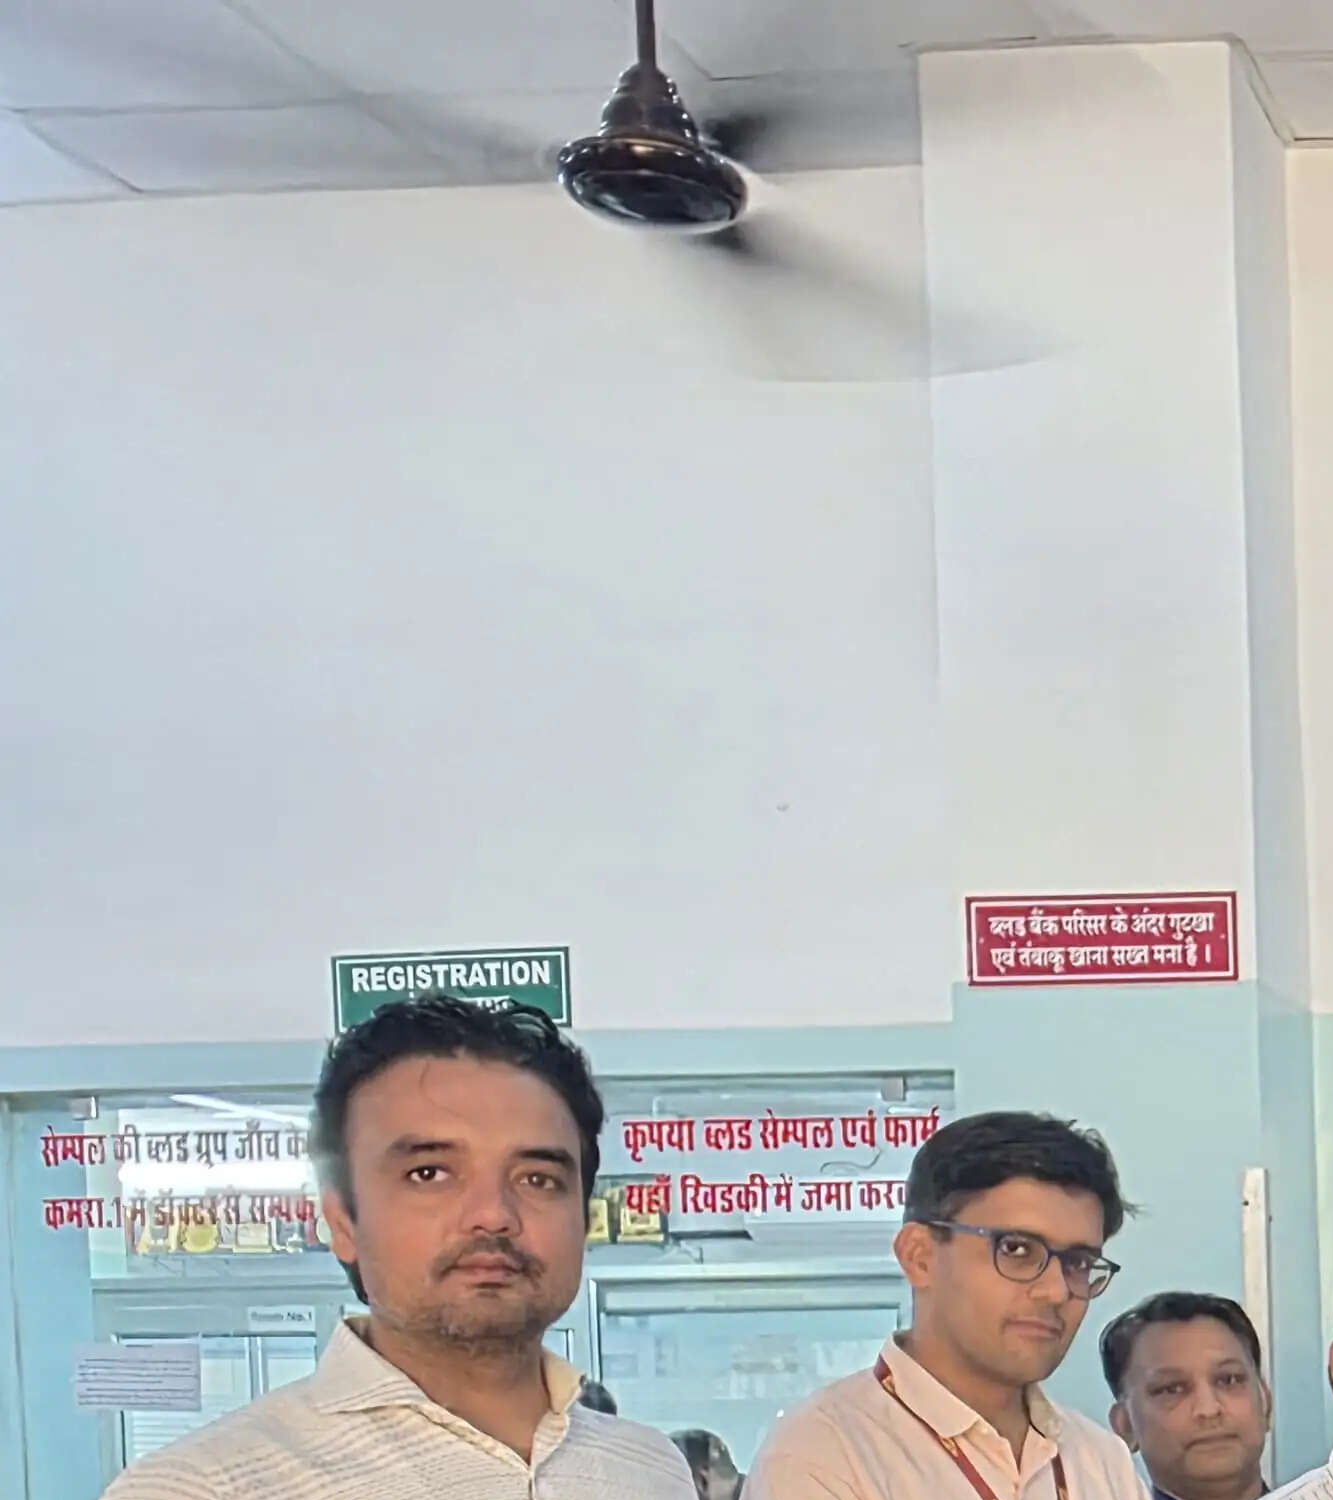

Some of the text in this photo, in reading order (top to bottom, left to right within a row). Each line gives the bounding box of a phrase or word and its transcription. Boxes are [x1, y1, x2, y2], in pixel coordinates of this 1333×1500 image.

[1109, 907, 1129, 934] के
[1068, 946, 1107, 967] खाना
[1151, 944, 1182, 964] मना
[352, 959, 550, 992] REGISTRATION
[111, 1124, 141, 1163] की
[622, 1119, 695, 1162] कृपया
[703, 1118, 753, 1151] ब्लड
[758, 1109, 834, 1150] सेम्पल
[839, 1109, 878, 1148] एवं
[771, 1173, 793, 1212] में
[799, 1180, 853, 1212] जमा
